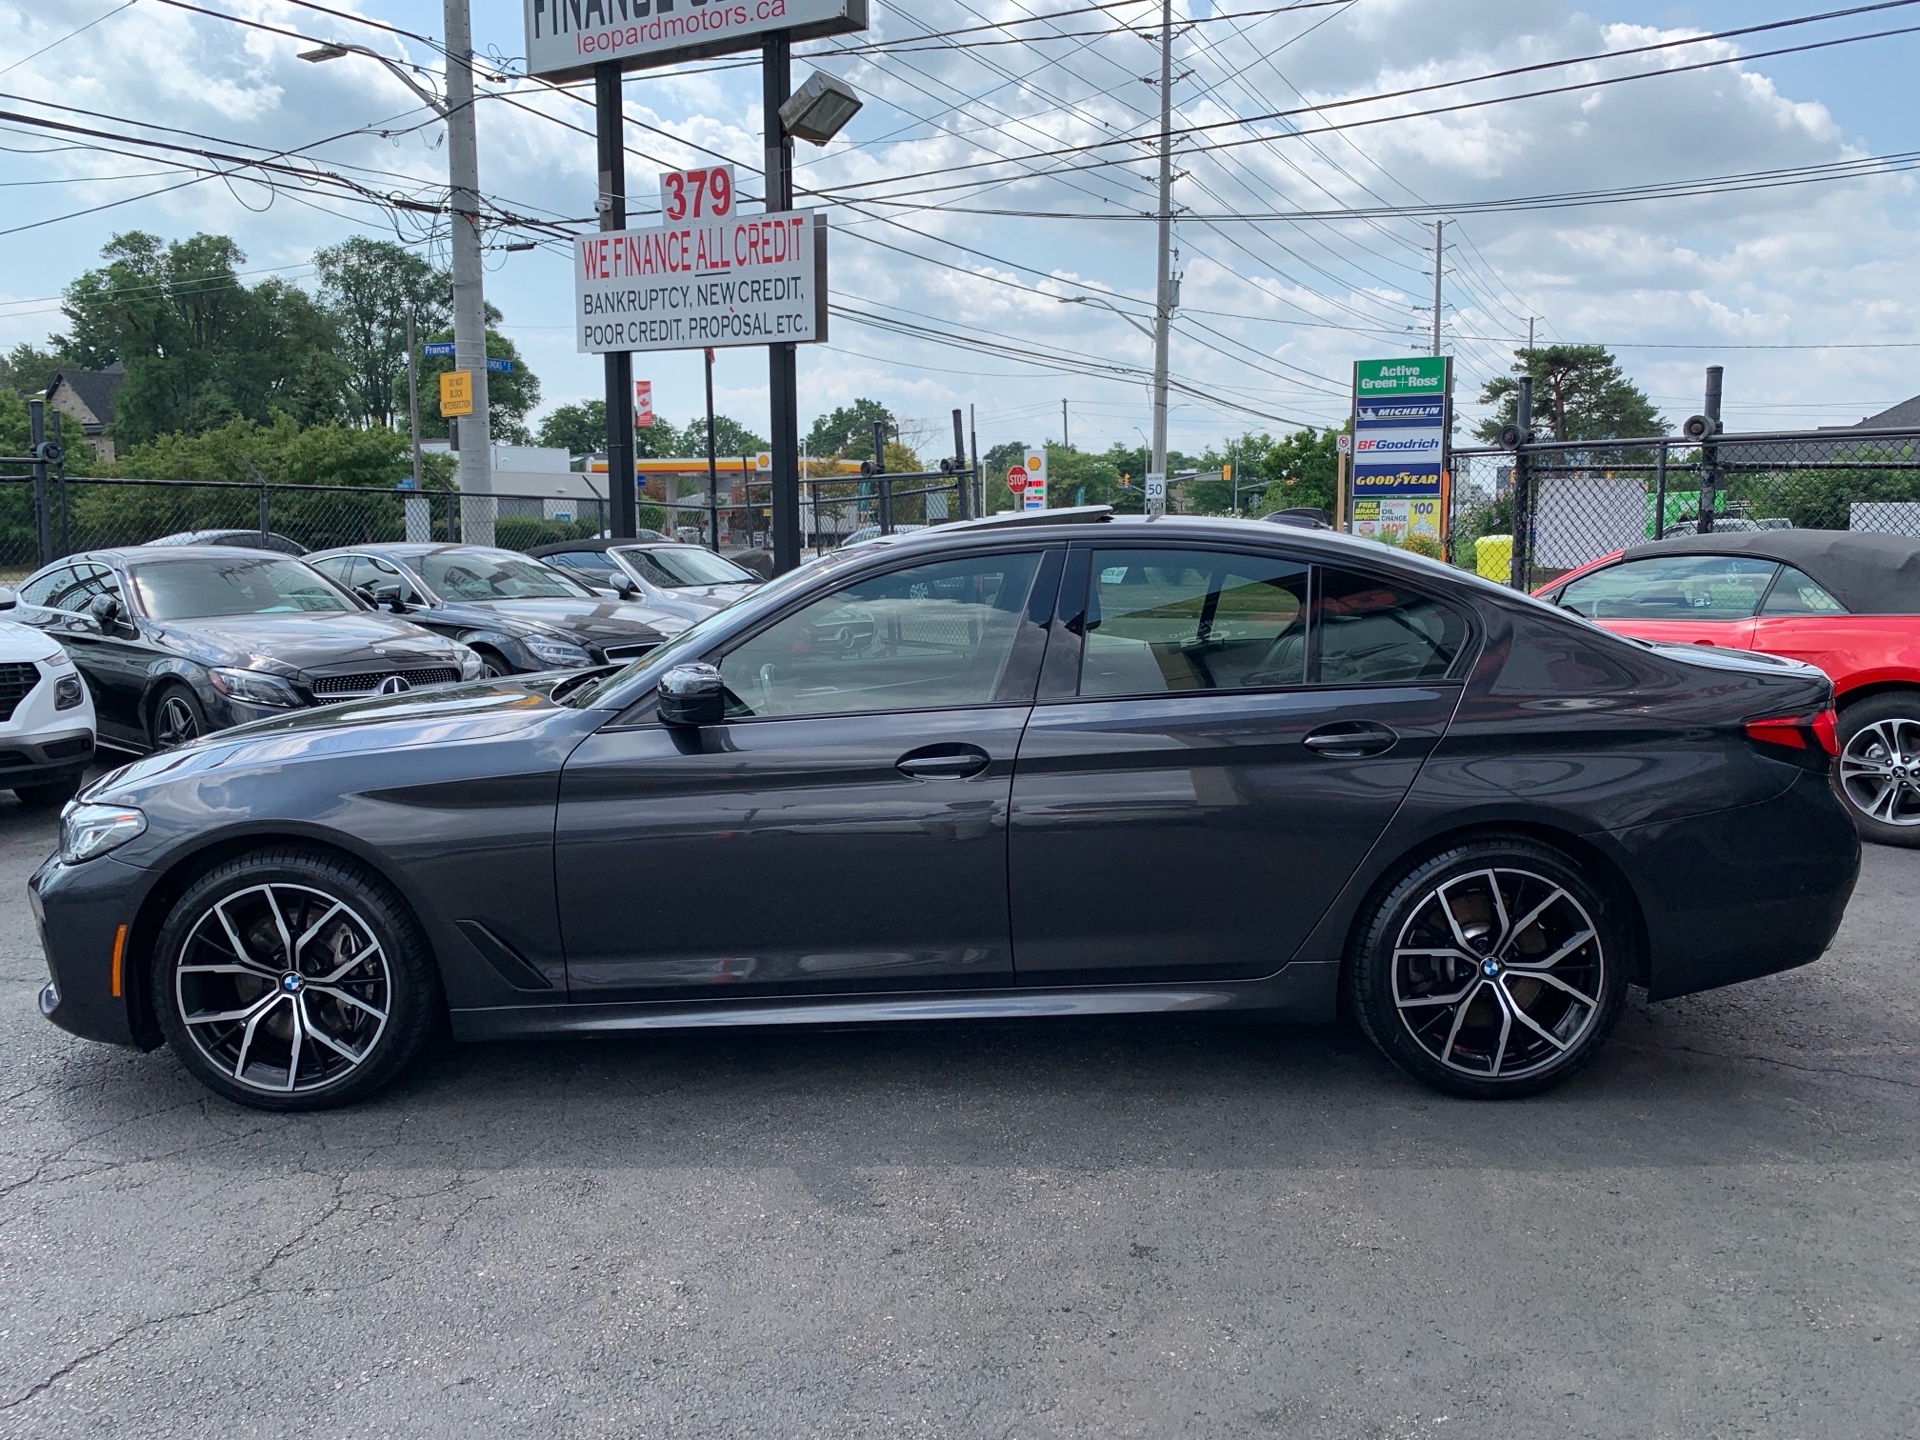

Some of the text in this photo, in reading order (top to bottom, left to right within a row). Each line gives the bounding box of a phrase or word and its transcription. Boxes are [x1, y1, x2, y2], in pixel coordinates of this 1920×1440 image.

[534, 0, 674, 39] FINA
[576, 0, 786, 55] leopardmotors.ca
[664, 167, 731, 221] 379
[581, 217, 803, 280] WE FINANCE ALL CREDIT
[583, 276, 804, 315] BANKRUPTCY, NEW CREDIT,
[584, 312, 808, 347] POOR CREDIT, PROPOSAL ETC.
[425, 345, 450, 355] Franze
[1379, 365, 1420, 377] Active
[448, 377, 464, 388] DO NOT
[449, 389, 463, 398] BLOCK
[443, 400, 471, 410] INTERSECTION
[1377, 407, 1440, 416] MICHELIN
[1357, 438, 1439, 450] BFGoodrich
[1009, 474, 1027, 486] STOP
[1148, 483, 1163, 496] 50
